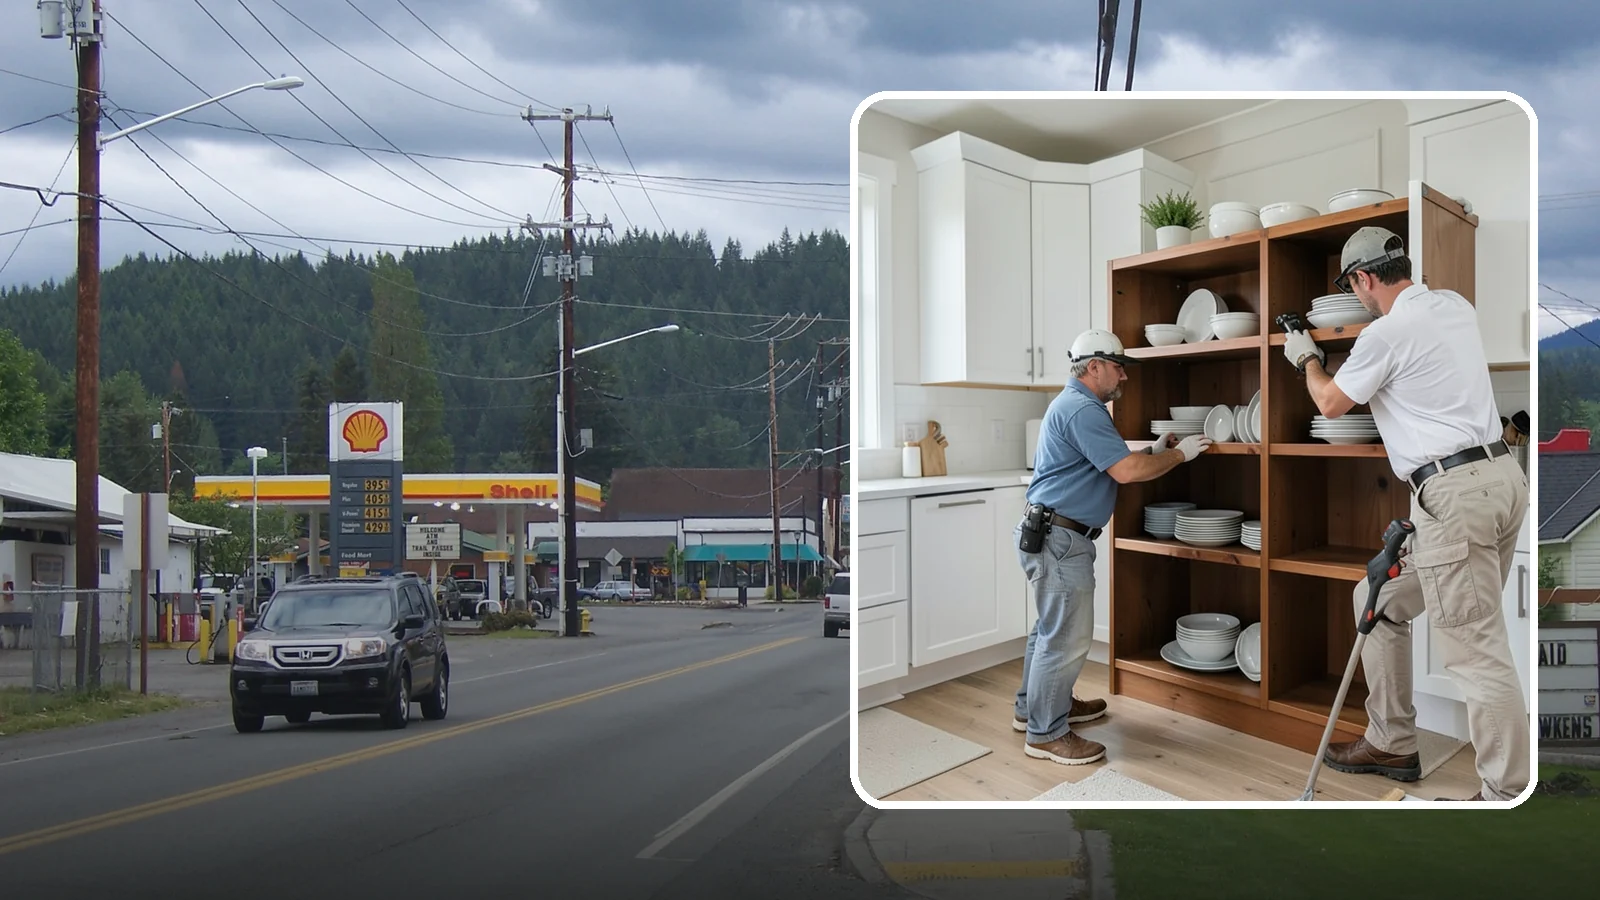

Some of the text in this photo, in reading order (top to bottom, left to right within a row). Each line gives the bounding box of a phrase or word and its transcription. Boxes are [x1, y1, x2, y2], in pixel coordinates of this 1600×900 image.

[365, 480, 384, 490] 395
[490, 484, 547, 499] Shell
[365, 494, 384, 504] 405
[365, 508, 384, 518] 415
[365, 522, 384, 533] 429
